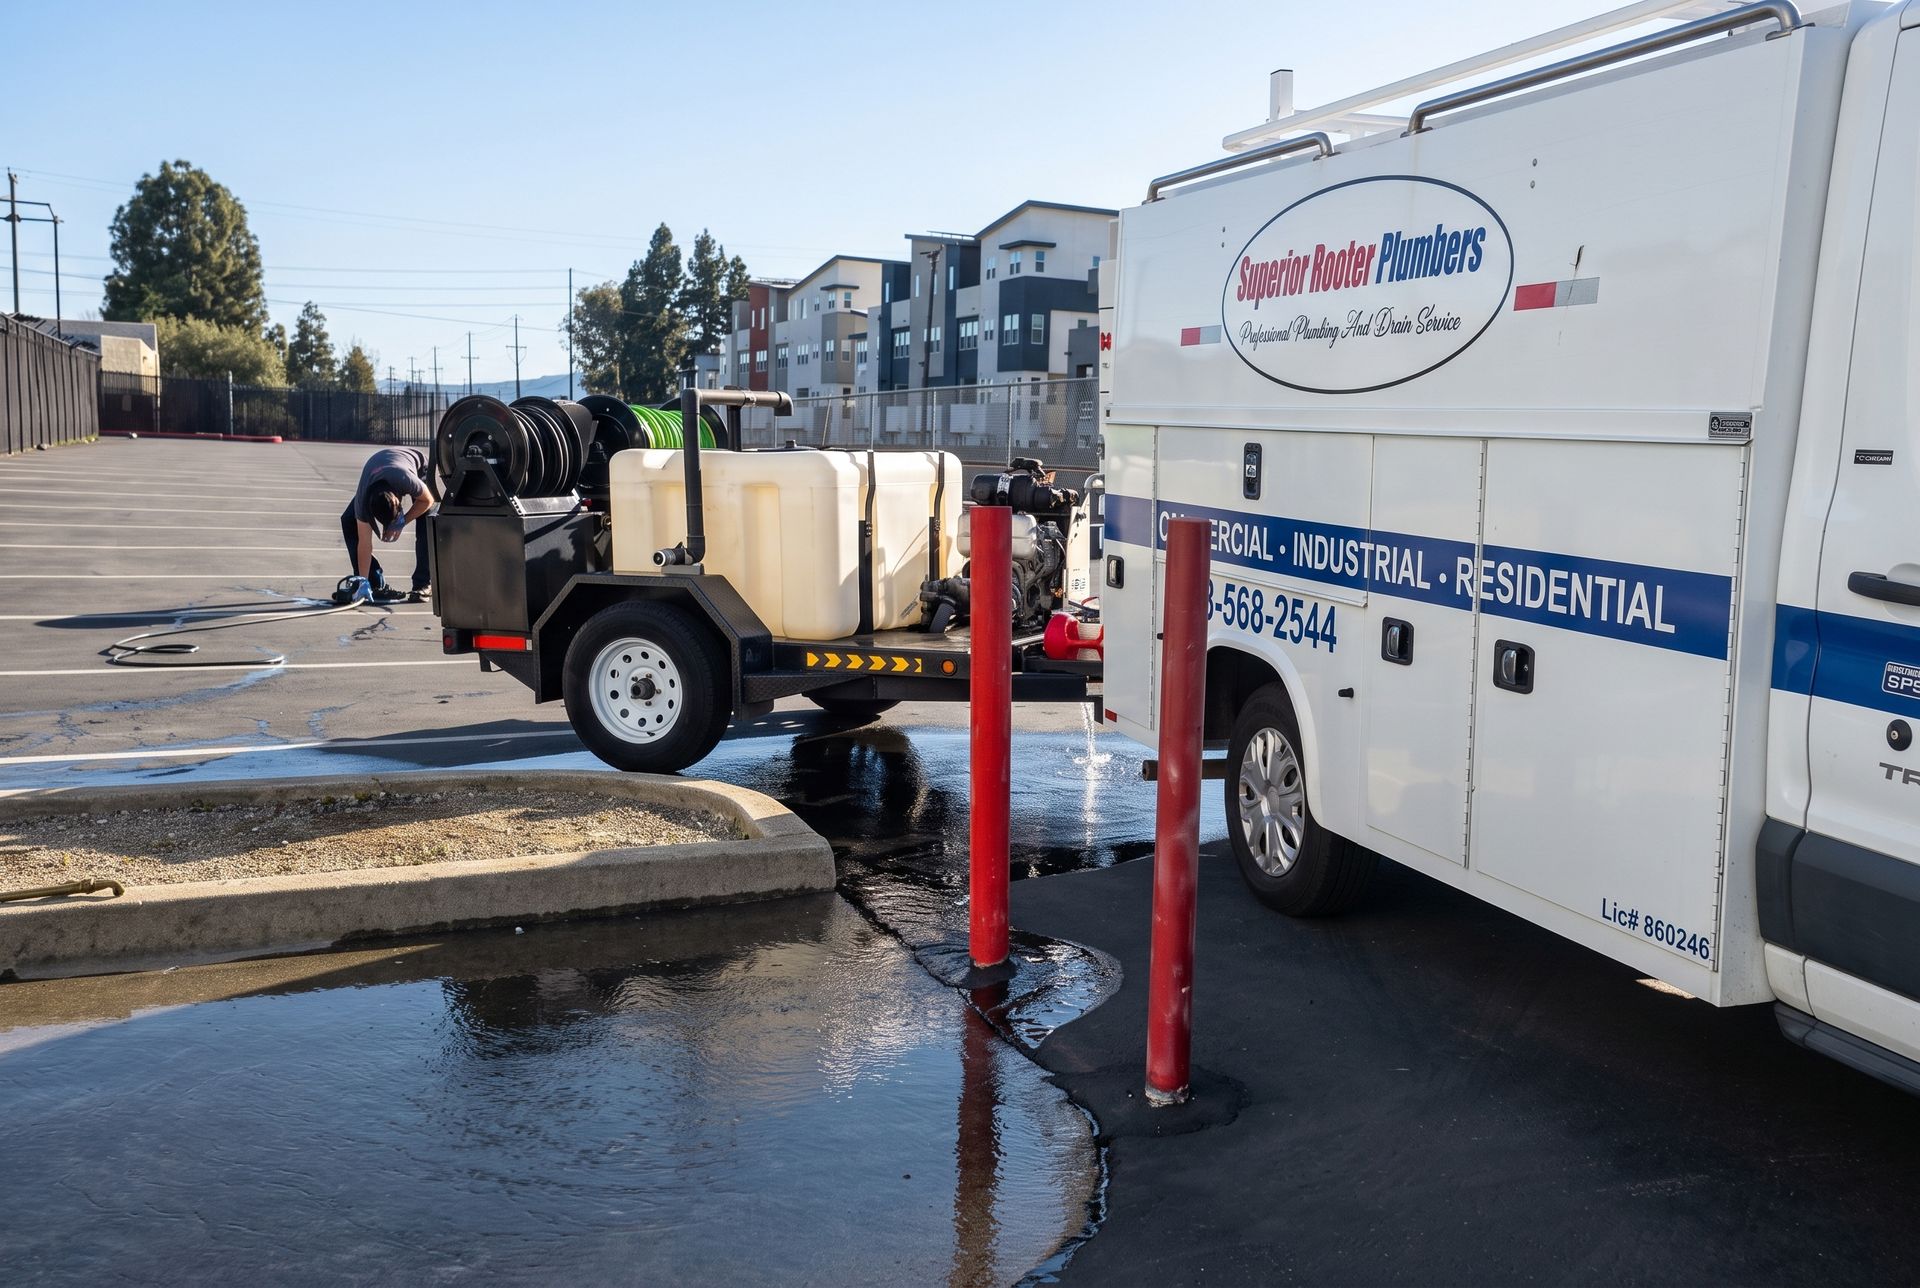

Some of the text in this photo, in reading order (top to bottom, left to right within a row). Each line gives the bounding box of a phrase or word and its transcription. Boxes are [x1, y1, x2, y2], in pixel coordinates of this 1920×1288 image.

[1237, 223, 1487, 310] Superior Rooter Plumbers
[1240, 304, 1462, 351] Professional Plumbing And Drain Service
[1293, 531, 1431, 589] INDUSTRIAL
[1456, 556, 1676, 634] RESIDENTIAL
[1602, 898, 1710, 960] Lic# 860246
